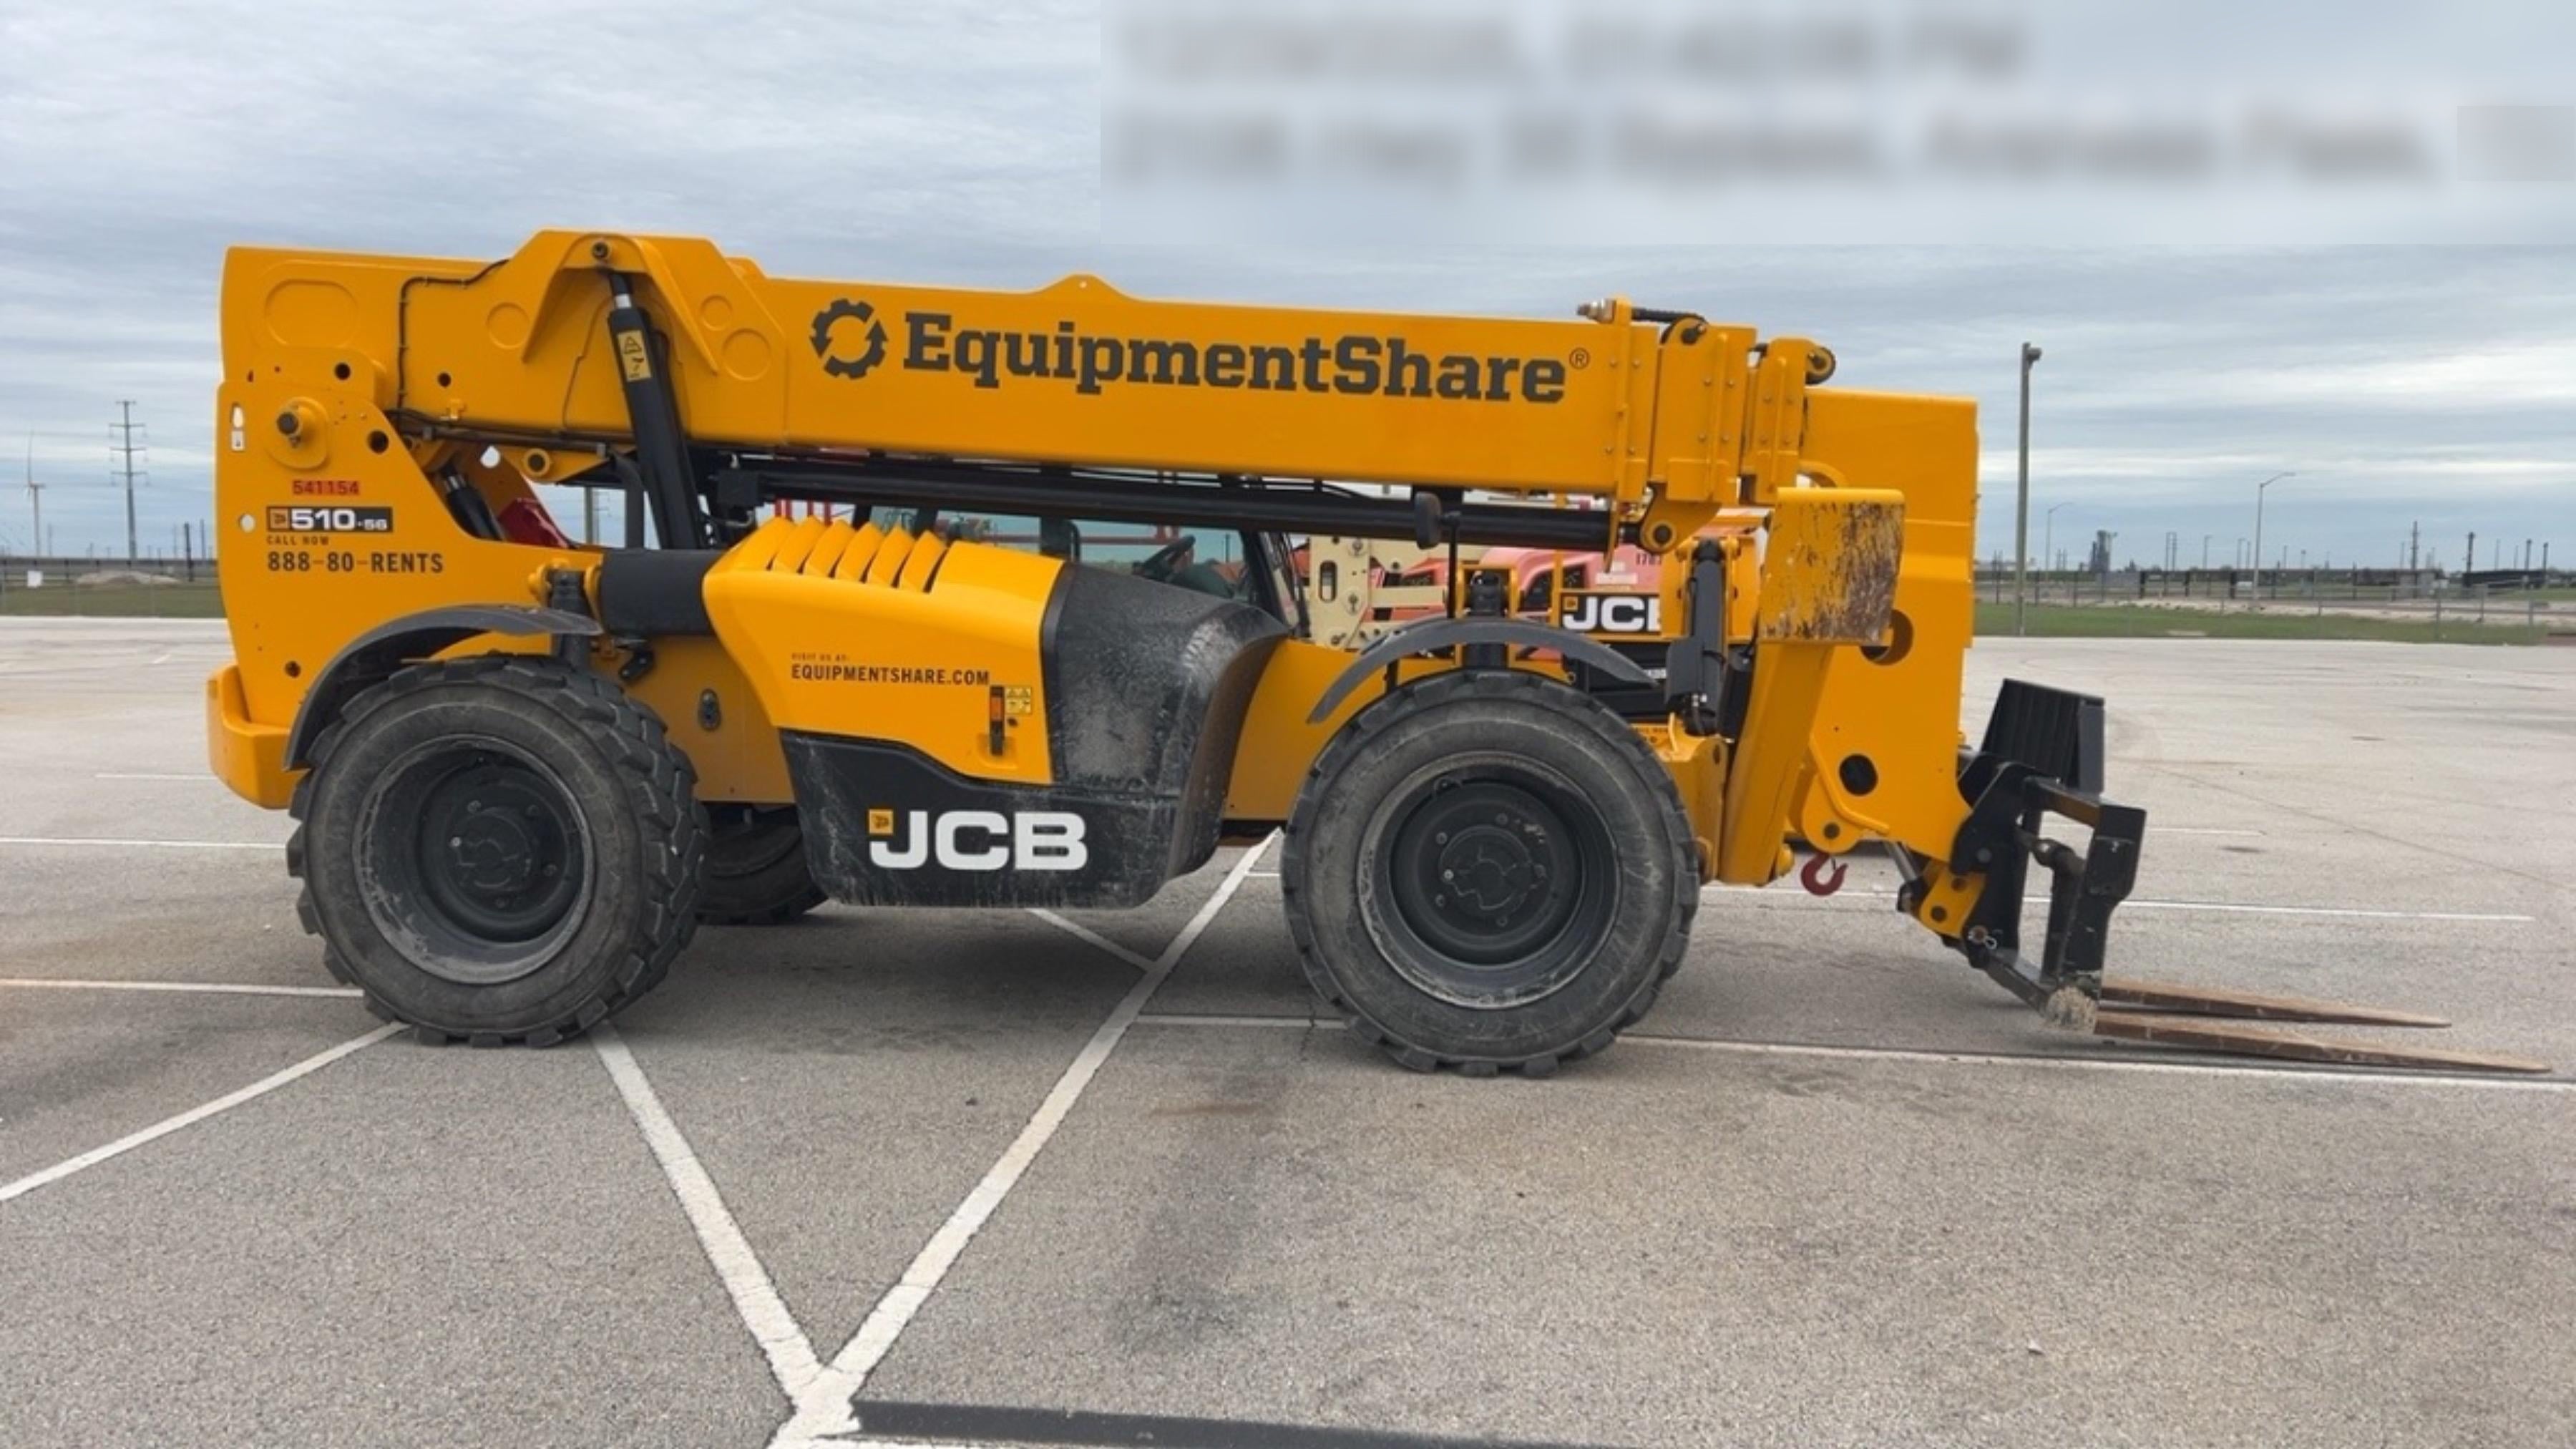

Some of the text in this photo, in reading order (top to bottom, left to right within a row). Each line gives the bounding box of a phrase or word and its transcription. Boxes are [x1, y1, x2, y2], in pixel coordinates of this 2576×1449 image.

[292, 480, 360, 496] 541154
[266, 535, 297, 546] CALL
[268, 551, 444, 572] 888-80-RENTS
[791, 663, 990, 686] EQUIPMENTSHARE.COM
[869, 811, 1088, 870] JCB
